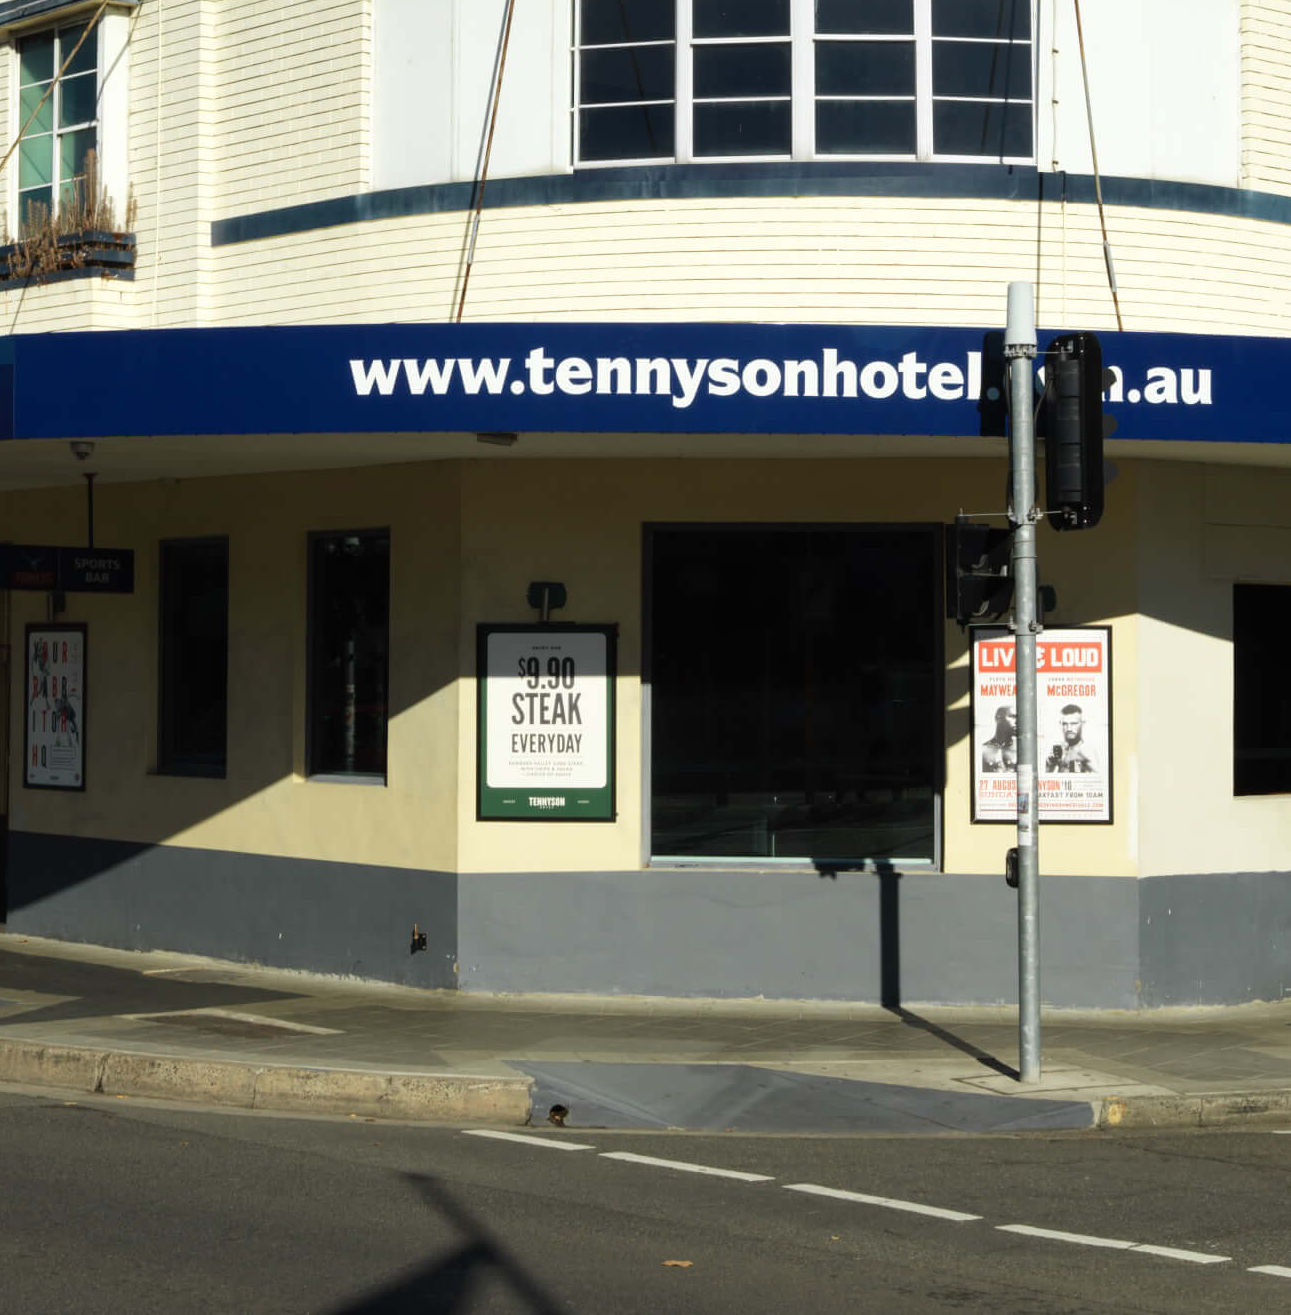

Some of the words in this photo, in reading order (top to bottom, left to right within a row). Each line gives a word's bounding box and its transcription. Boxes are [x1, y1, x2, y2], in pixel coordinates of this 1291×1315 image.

[74, 557, 121, 571] SPORTS
[85, 571, 109, 583] BAR
[981, 647, 1015, 668] LIV
[1050, 647, 1099, 668] LOUD
[517, 656, 576, 690] $9.90
[1046, 684, 1097, 697] McGREGOR
[511, 692, 582, 726] STEAK
[511, 733, 583, 754] EVERYDAY
[992, 779, 1017, 791] AUGUS
[528, 796, 566, 807] TENNYSON
